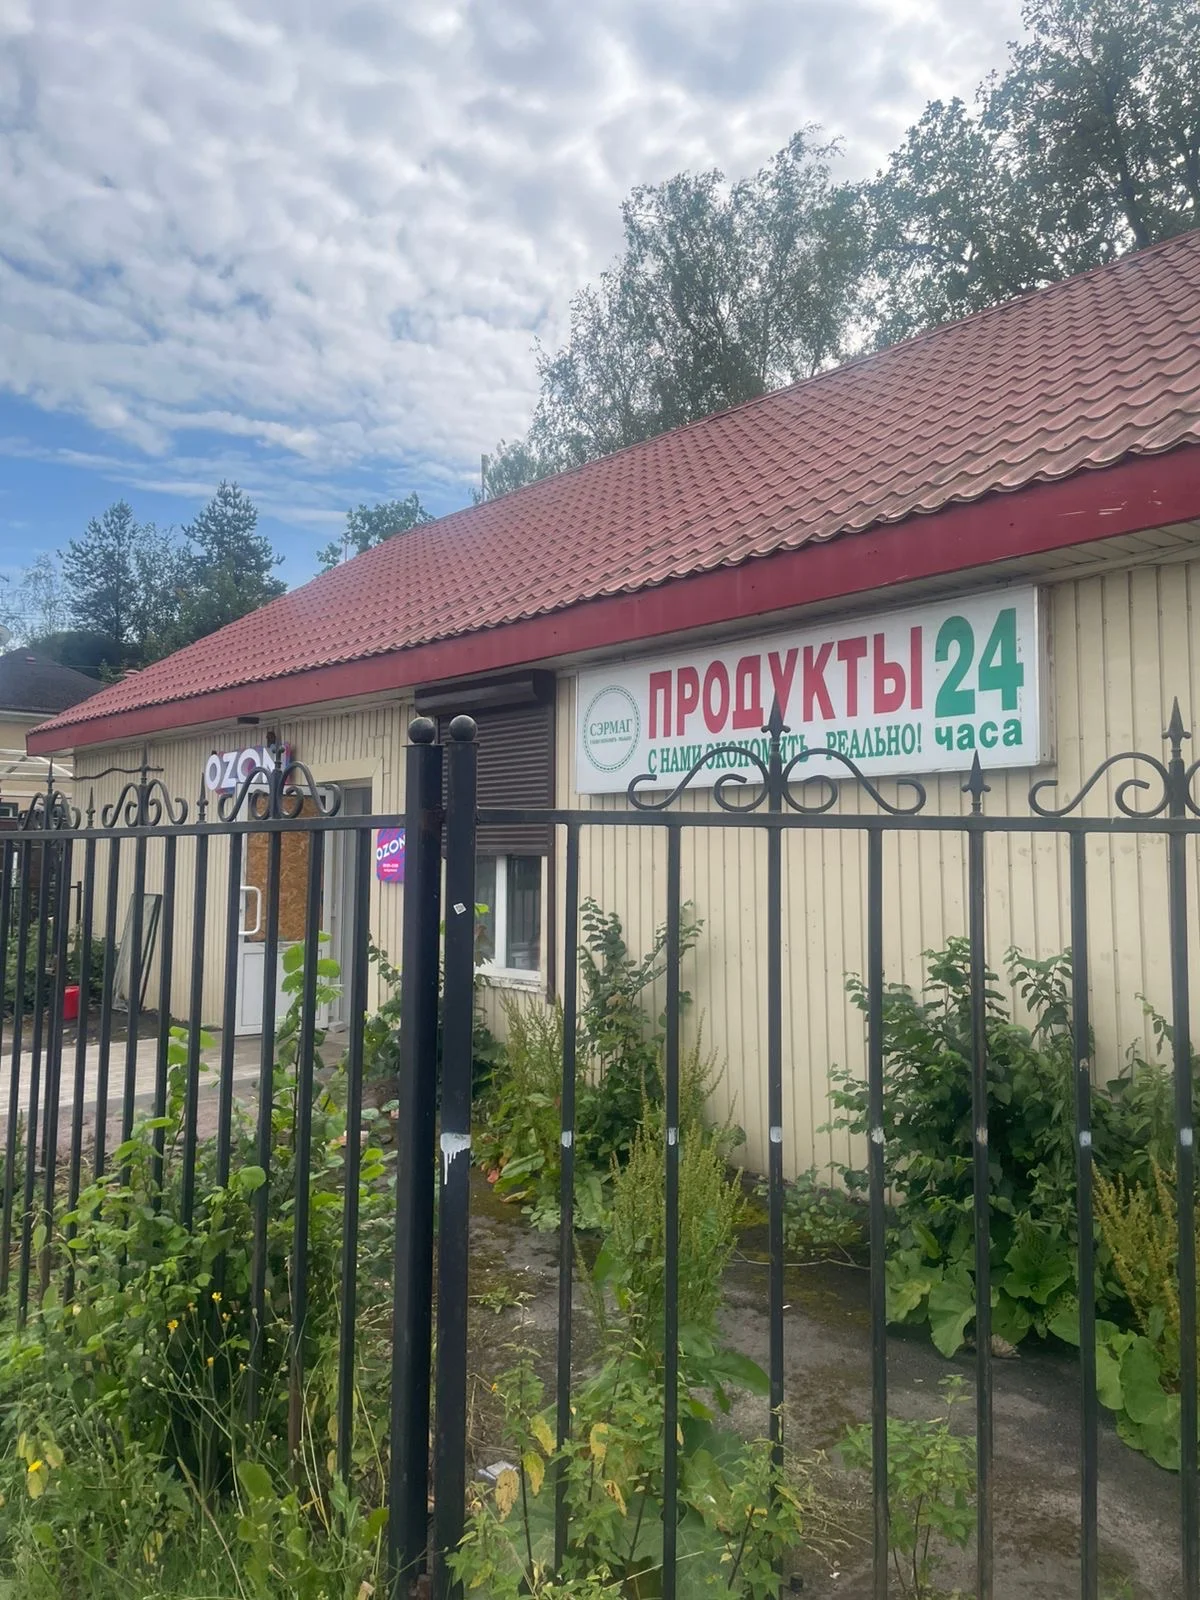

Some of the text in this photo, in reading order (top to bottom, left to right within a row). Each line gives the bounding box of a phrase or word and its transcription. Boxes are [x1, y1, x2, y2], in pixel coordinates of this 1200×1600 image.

[648, 607, 1024, 740] ПРОДУКТЫ 24
[589, 718, 633, 737] СЭРМАГ
[647, 748, 657, 774] С
[825, 722, 922, 761] РЕАЛЬНО!
[935, 718, 1023, 751] часа
